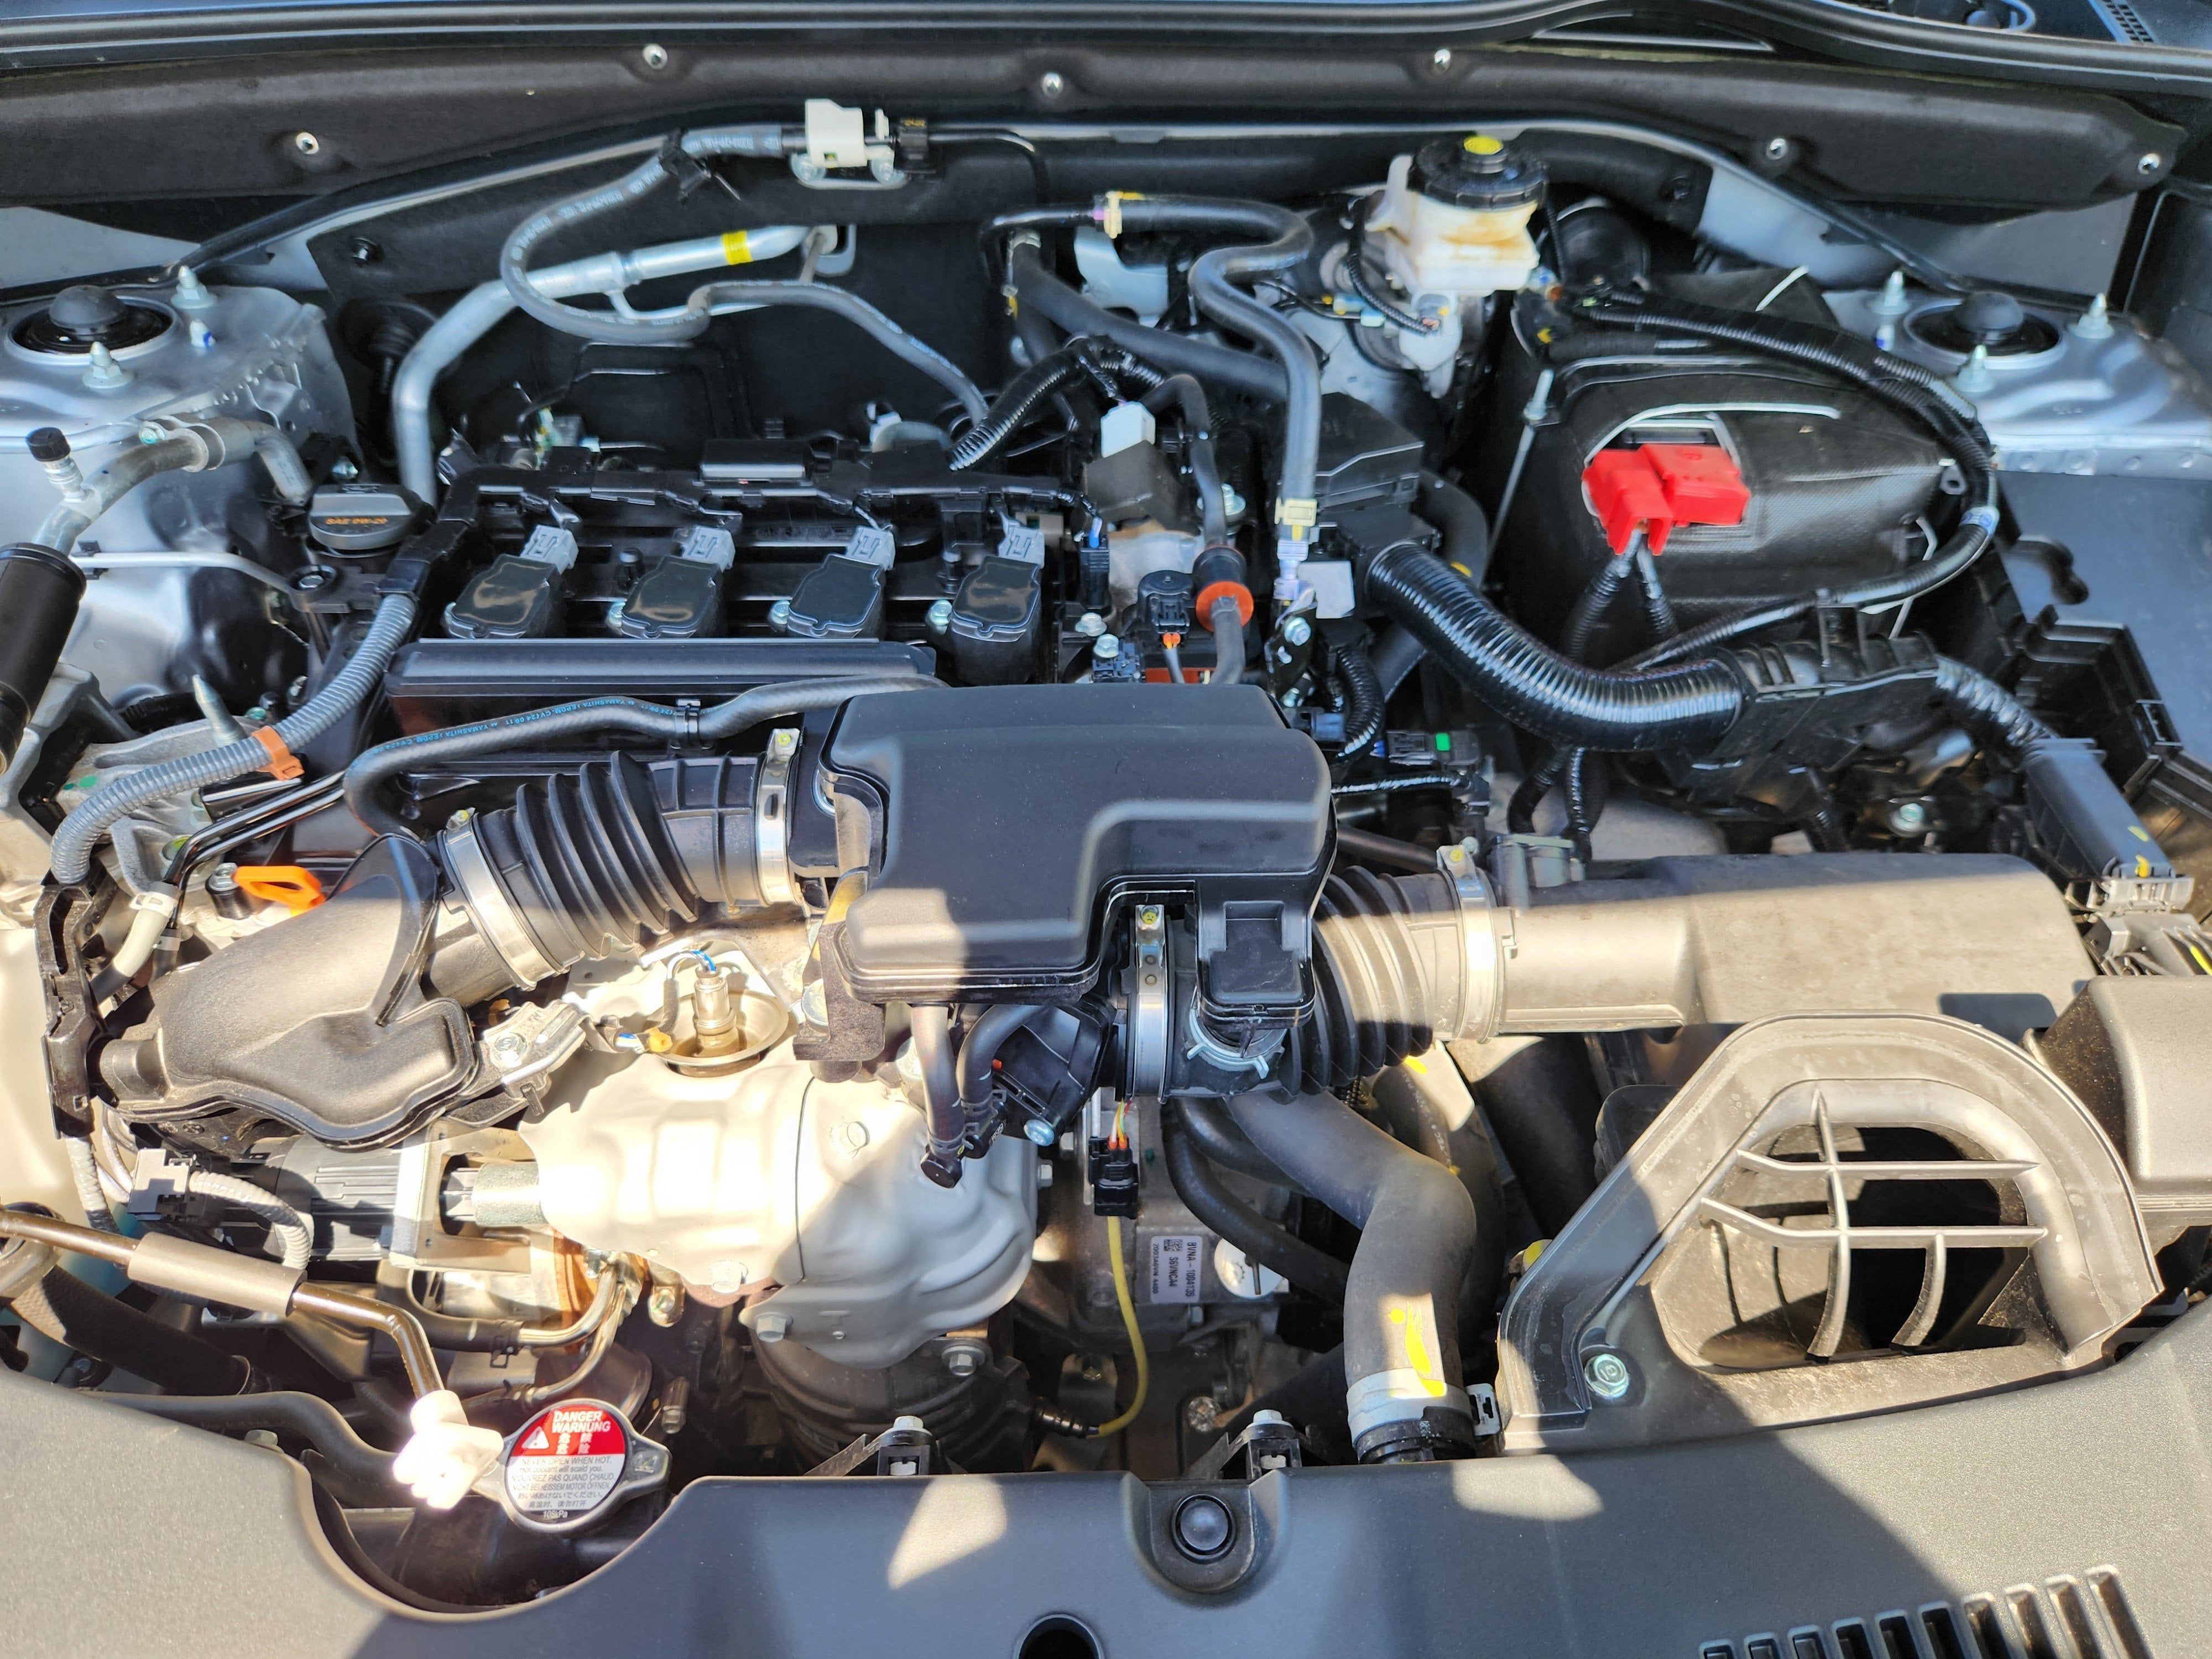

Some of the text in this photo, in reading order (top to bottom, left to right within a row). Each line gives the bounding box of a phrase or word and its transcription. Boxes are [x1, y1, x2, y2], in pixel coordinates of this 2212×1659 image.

[583, 699, 625, 707] YAMASHITA
[446, 723, 489, 738] YAMASHITA
[1187, 1242, 1197, 1261] BVNA
[554, 1411, 603, 1422] DANGER
[552, 1421, 611, 1433] WARNUNG
